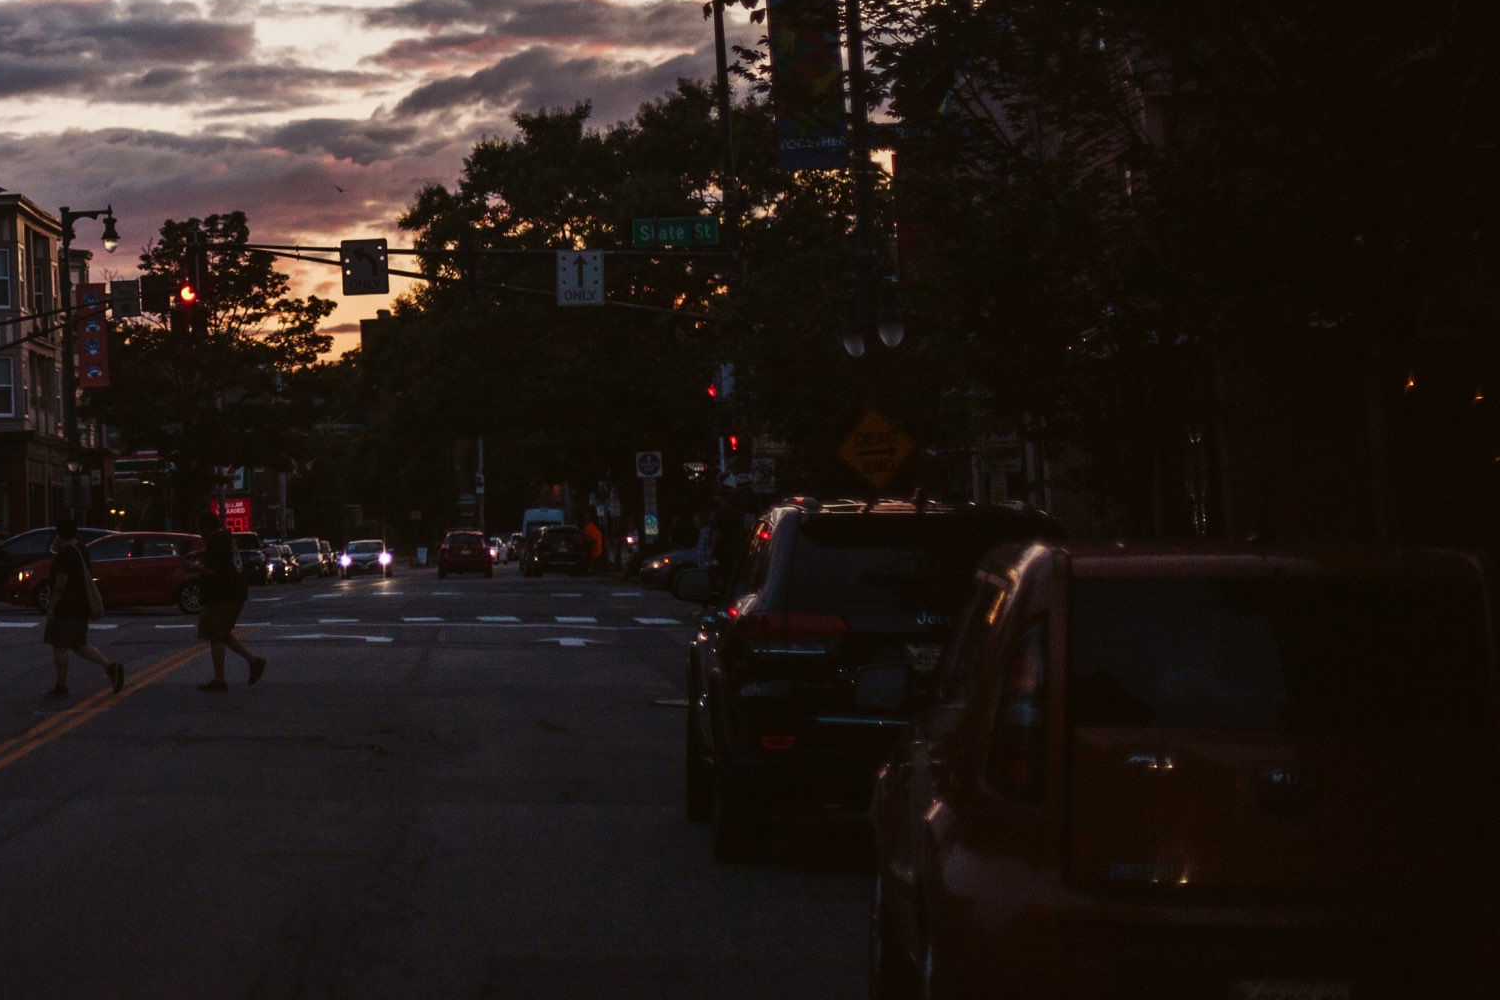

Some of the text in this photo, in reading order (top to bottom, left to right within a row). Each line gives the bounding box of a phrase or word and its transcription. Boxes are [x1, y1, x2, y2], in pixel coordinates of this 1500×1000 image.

[779, 135, 847, 150] TOGETHER
[640, 222, 711, 241] State St
[349, 278, 382, 290] ONLY
[564, 289, 596, 301] ONLY
[855, 430, 897, 447] DEAD
[864, 457, 894, 474] END
